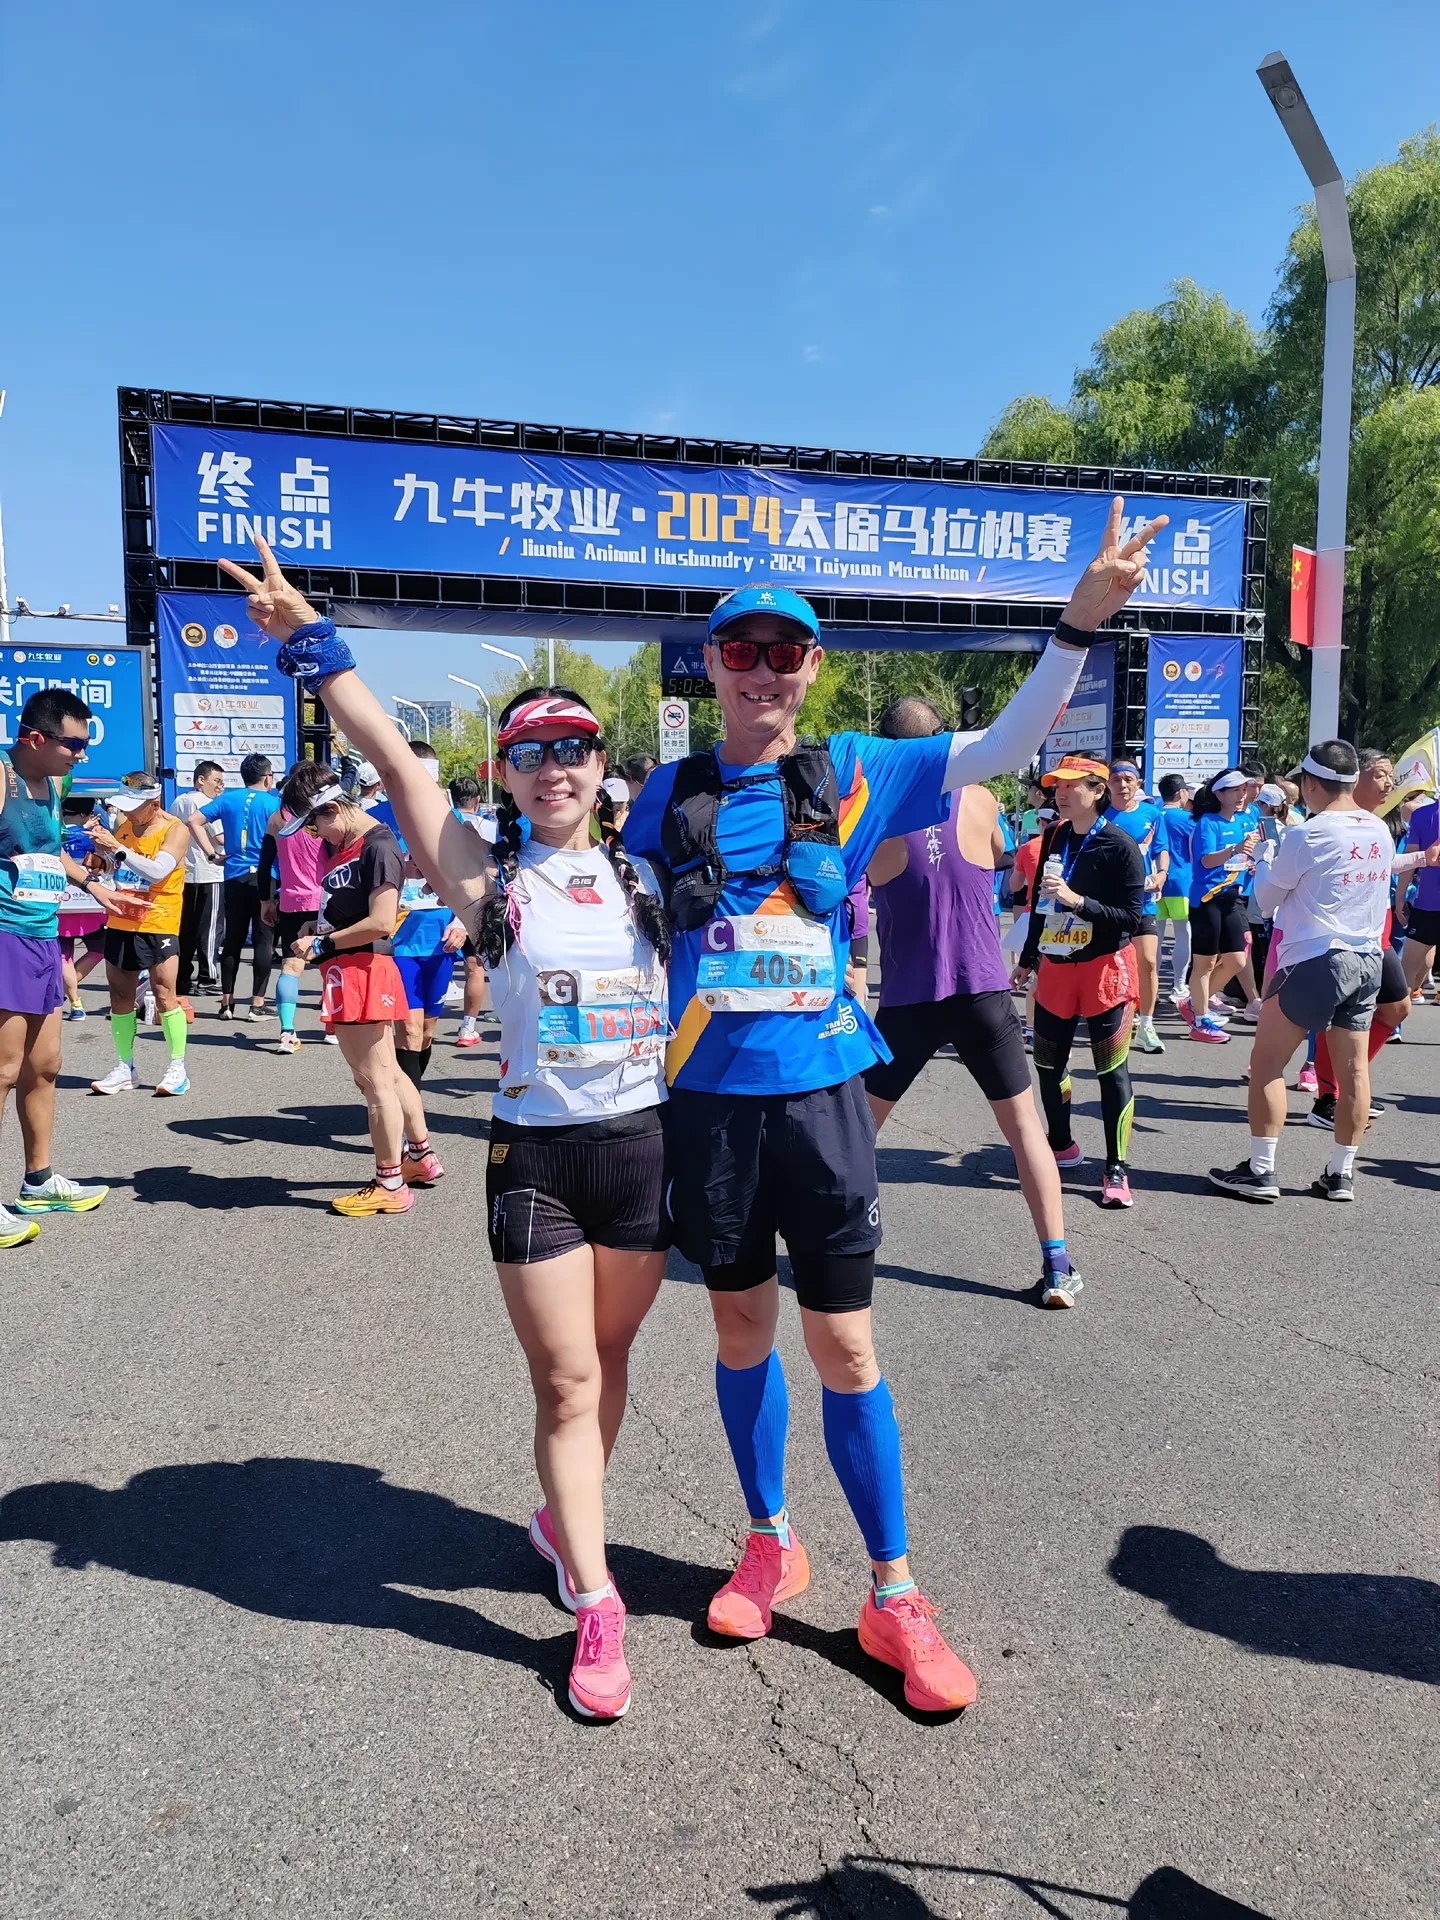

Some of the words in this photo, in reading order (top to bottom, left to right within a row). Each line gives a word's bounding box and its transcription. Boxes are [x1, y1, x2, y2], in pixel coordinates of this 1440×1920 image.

[197, 451, 330, 514] 终点
[197, 511, 332, 550] FINISH
[520, 538, 575, 560] Jiuniu
[584, 543, 647, 564] Animal
[654, 547, 754, 573] Husbandry
[770, 554, 806, 572] 2024
[813, 556, 882, 579] Taiyuan
[888, 561, 970, 582] Marathon
[1134, 568, 1210, 595] NISH
[1349, 841, 1381, 861] 太原
[708, 921, 728, 951] C
[547, 973, 573, 1004] G
